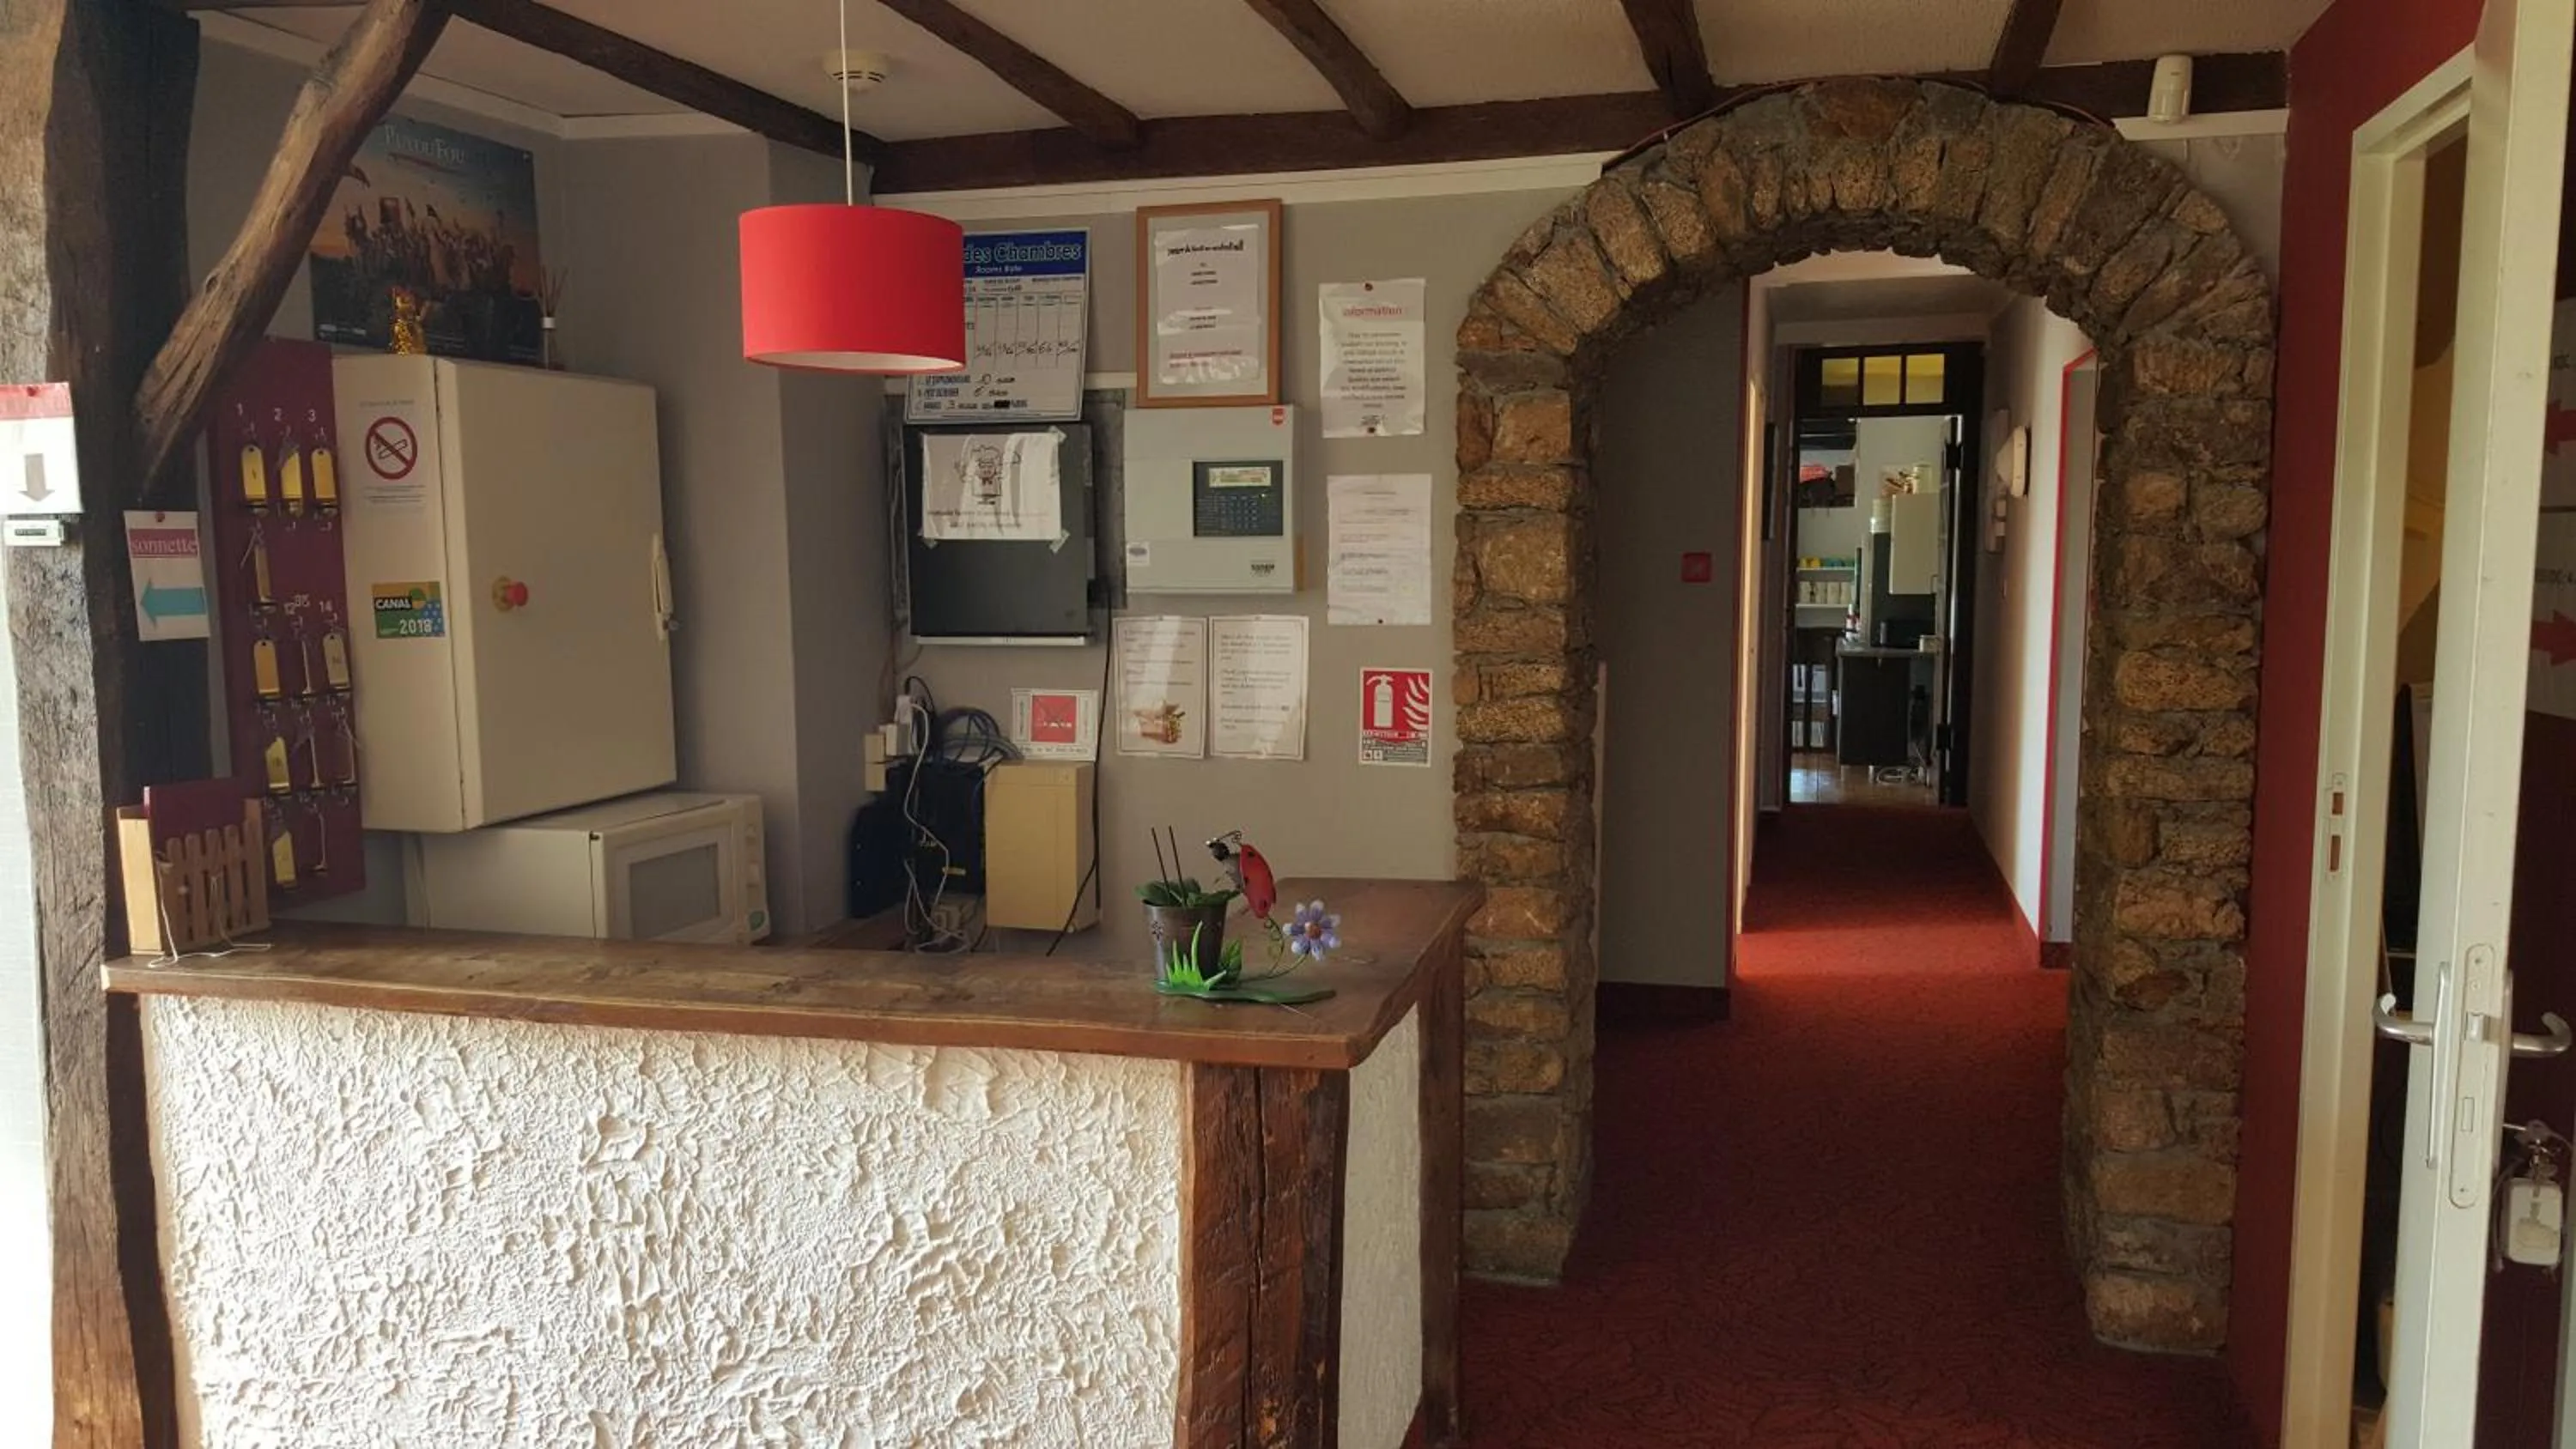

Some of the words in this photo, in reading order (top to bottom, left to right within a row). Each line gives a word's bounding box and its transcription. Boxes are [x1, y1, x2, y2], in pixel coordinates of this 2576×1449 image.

[994, 239, 1083, 264] Chambres
[273, 407, 283, 422] 2
[307, 408, 317, 423] 3
[374, 597, 412, 609] CANAL
[398, 617, 433, 635] 2018
